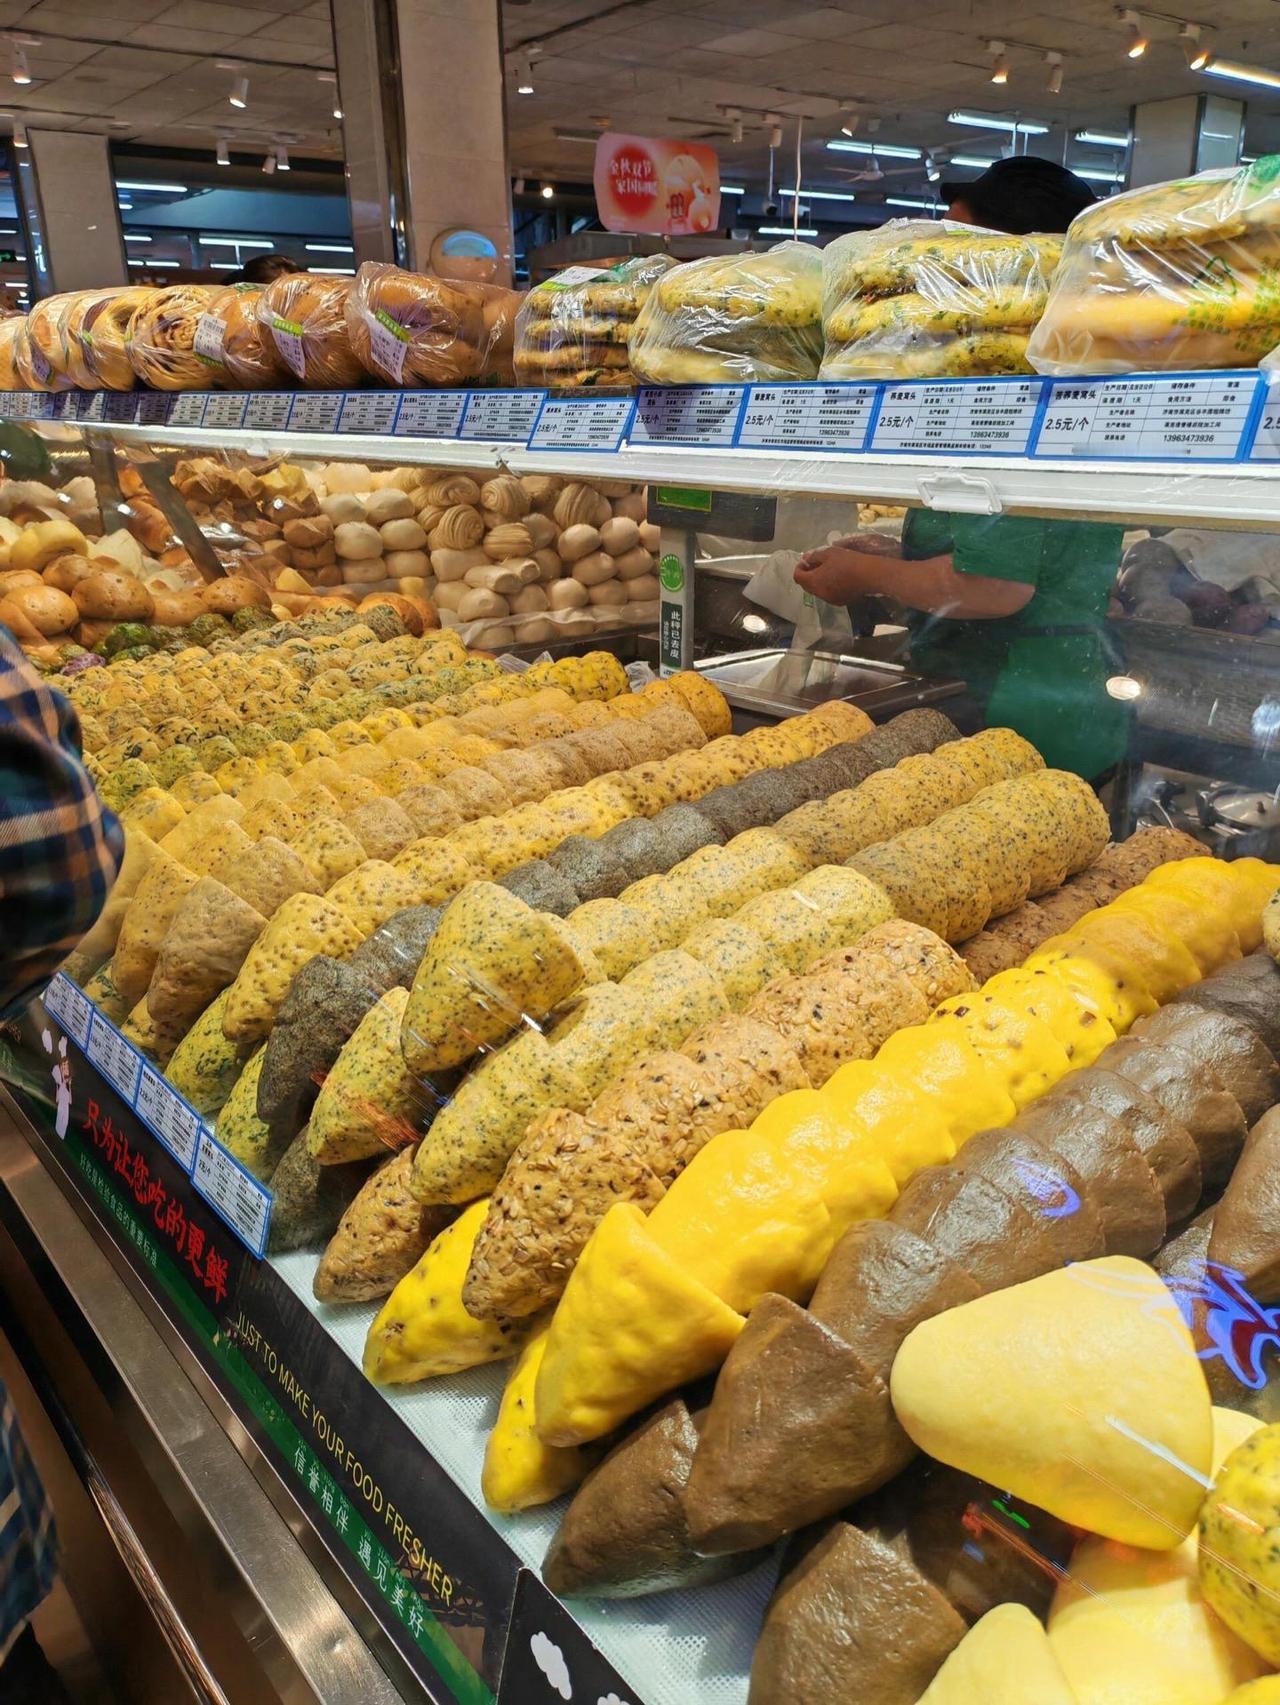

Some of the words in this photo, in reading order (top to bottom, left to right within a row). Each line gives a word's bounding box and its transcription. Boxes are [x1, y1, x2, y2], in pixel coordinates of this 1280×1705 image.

[1103, 382, 1128, 392] 生产日期
[890, 392, 916, 401] 荞麦窝头
[1054, 390, 1097, 401] 苦荞麦窝头
[1167, 395, 1192, 404] 食用方法
[745, 414, 774, 426] 2.5元/个
[879, 415, 914, 428] 2.5元/个
[1044, 416, 1090, 432] 2.5元/个
[1163, 434, 1215, 443] 13963473936
[669, 610, 681, 659] 此秤已去皮
[82, 1097, 228, 1304] 只为让您吃的更鲜
[236, 1312, 264, 1354] JUST
[262, 1344, 278, 1374] TO
[278, 1362, 311, 1418] MAKE
[312, 1407, 344, 1465] YOUR
[345, 1451, 383, 1513] FOOD
[385, 1502, 453, 1606] FRESHER
[293, 1446, 351, 1534] 信誉相伴
[357, 1534, 426, 1639] 遇见美好
